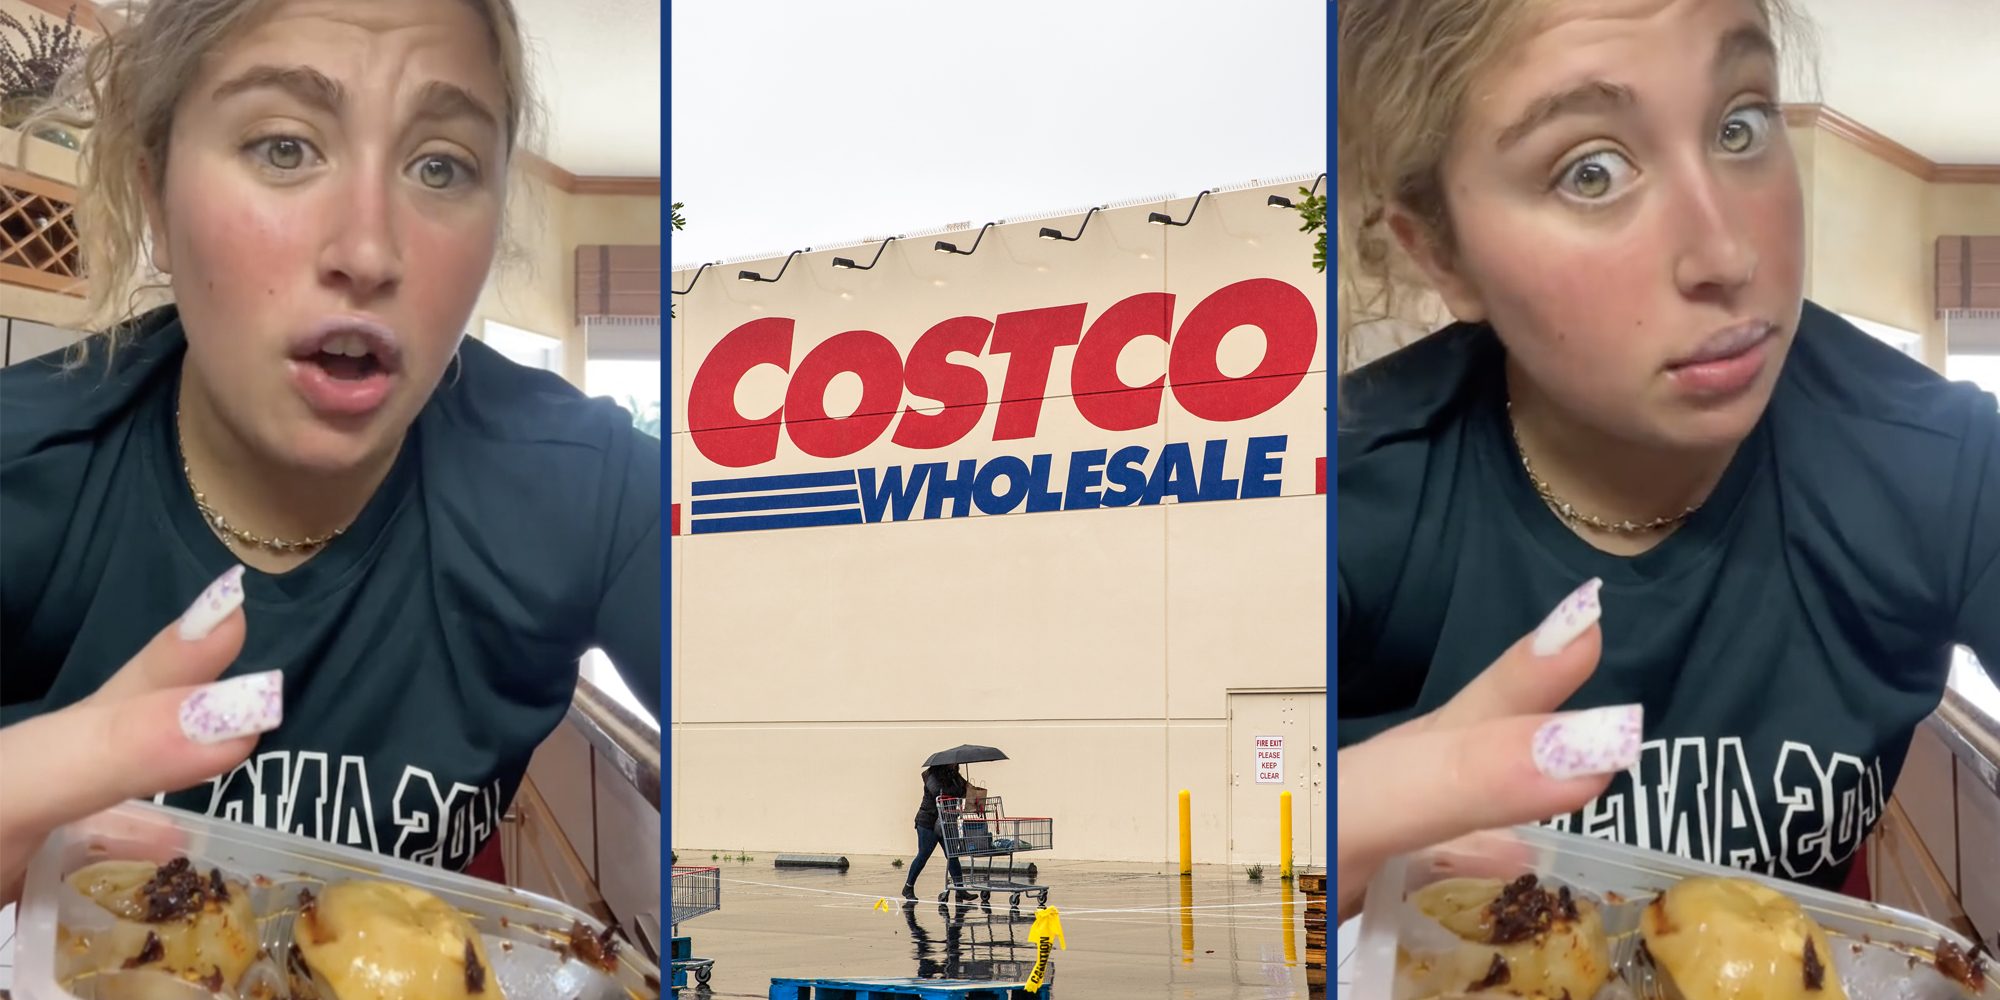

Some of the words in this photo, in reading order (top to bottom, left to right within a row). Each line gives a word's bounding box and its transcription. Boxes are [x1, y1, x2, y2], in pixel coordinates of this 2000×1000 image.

[687, 277, 1318, 468] COSTCO
[857, 434, 1288, 524] WHOLESALE
[1256, 739, 1268, 747] FIRE
[1269, 739, 1282, 747] EXIT
[1258, 751, 1281, 759] PLEASE
[1030, 936, 1051, 984] CAUTION
